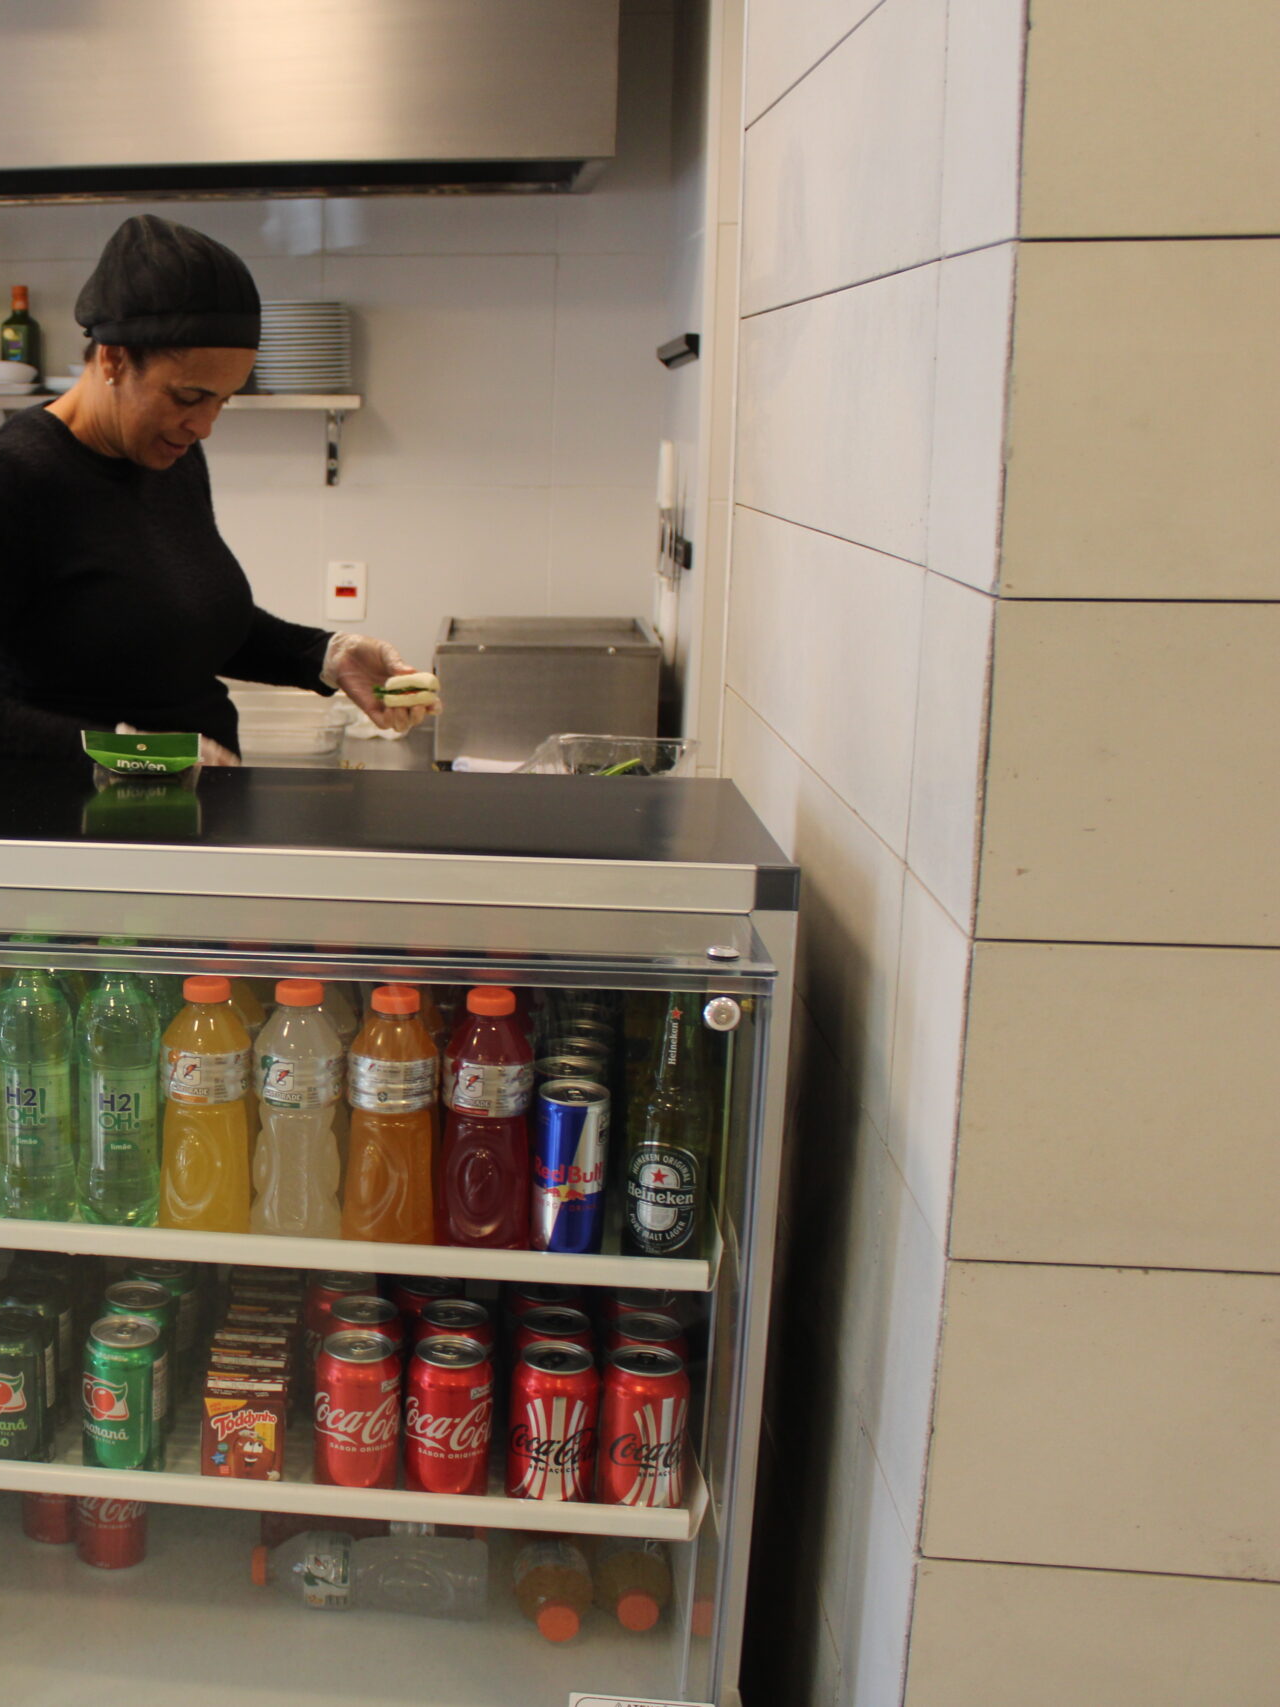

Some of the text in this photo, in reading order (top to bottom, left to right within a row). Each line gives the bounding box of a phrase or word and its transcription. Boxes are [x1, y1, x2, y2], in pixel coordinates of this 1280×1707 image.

[667, 1022, 679, 1065] Heineken
[6, 1086, 37, 1106] H2
[99, 1093, 132, 1111] H2
[110, 1143, 132, 1151] limão
[535, 1156, 604, 1184] Red Bull
[663, 1155, 692, 1182] ORIGINAL
[627, 1181, 694, 1205] Heineken
[665, 1220, 686, 1240] LAGER
[211, 1409, 277, 1441] Toddynho
[314, 1391, 399, 1445] Coca-Col
[82, 1420, 129, 1440] araná
[418, 1447, 484, 1459] SABOR ORIGIN
